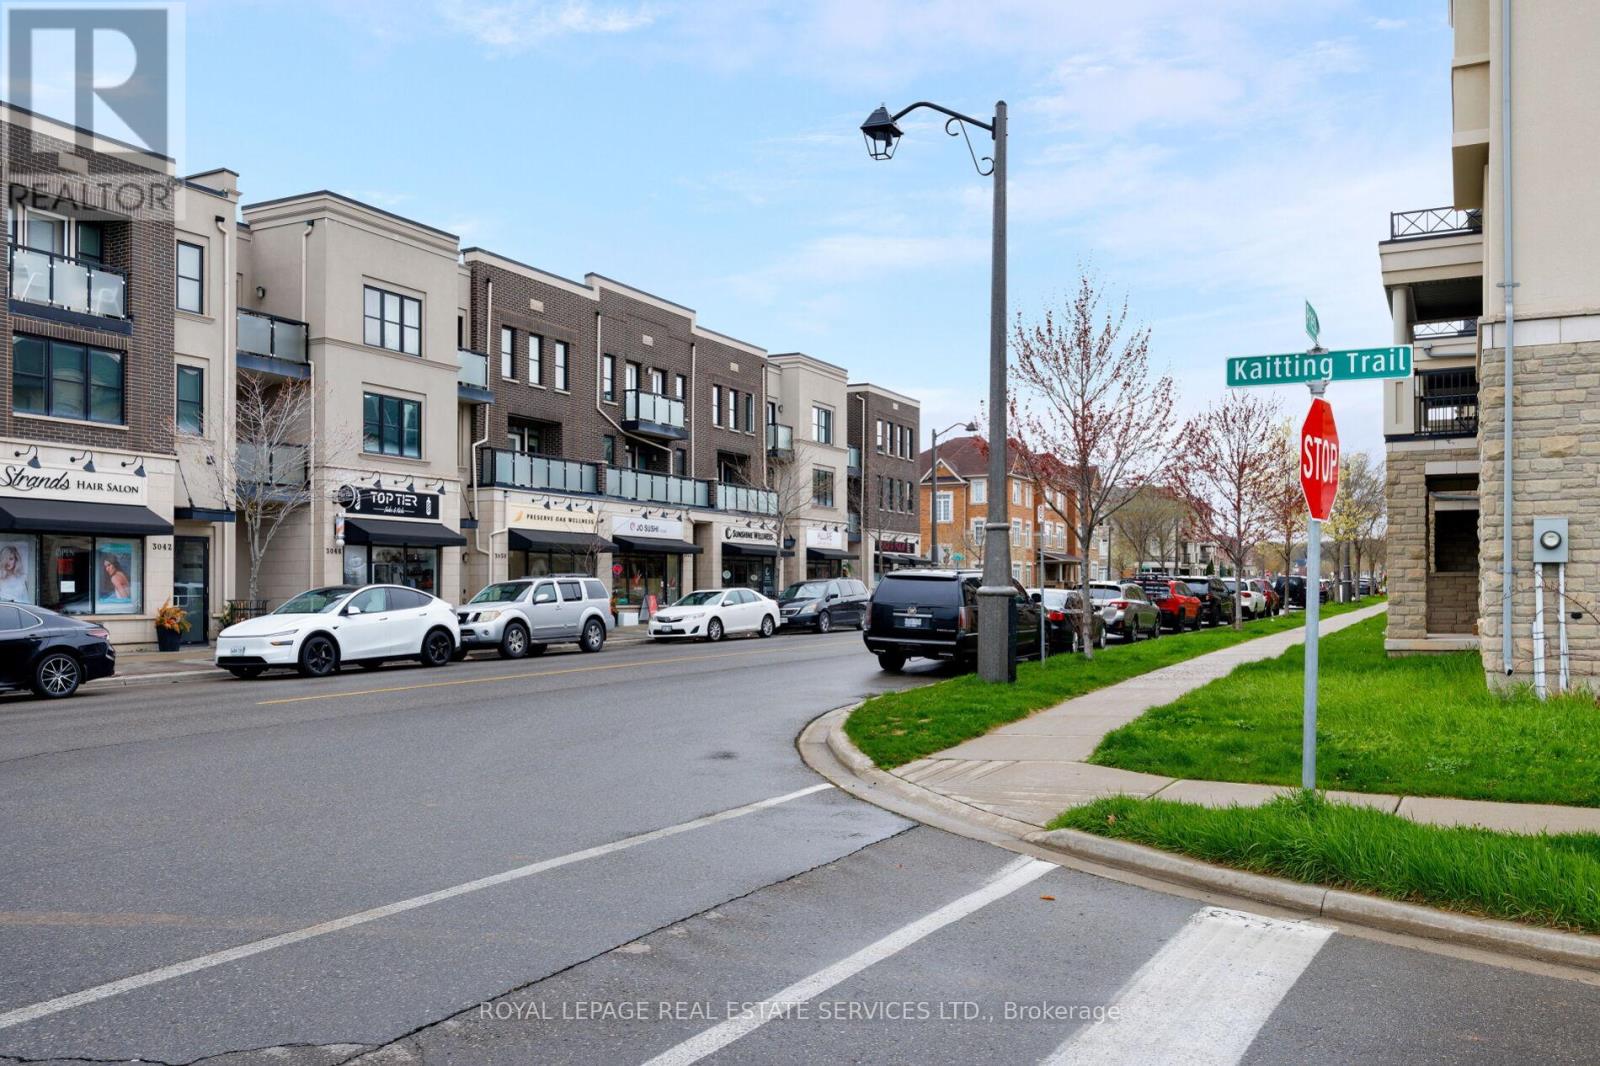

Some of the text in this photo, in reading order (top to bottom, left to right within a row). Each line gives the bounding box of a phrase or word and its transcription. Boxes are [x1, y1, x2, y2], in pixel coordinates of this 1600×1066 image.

[1234, 348, 1406, 381] Kaitting Trail
[1303, 434, 1338, 483] STOP
[0, 465, 70, 491] Strands
[370, 491, 394, 504] TOP
[395, 493, 418, 507] TIER
[526, 513, 554, 522] PRESERVE
[568, 517, 595, 525] WELLNESS
[644, 525, 659, 533] SUSHI
[152, 543, 172, 551] 3042
